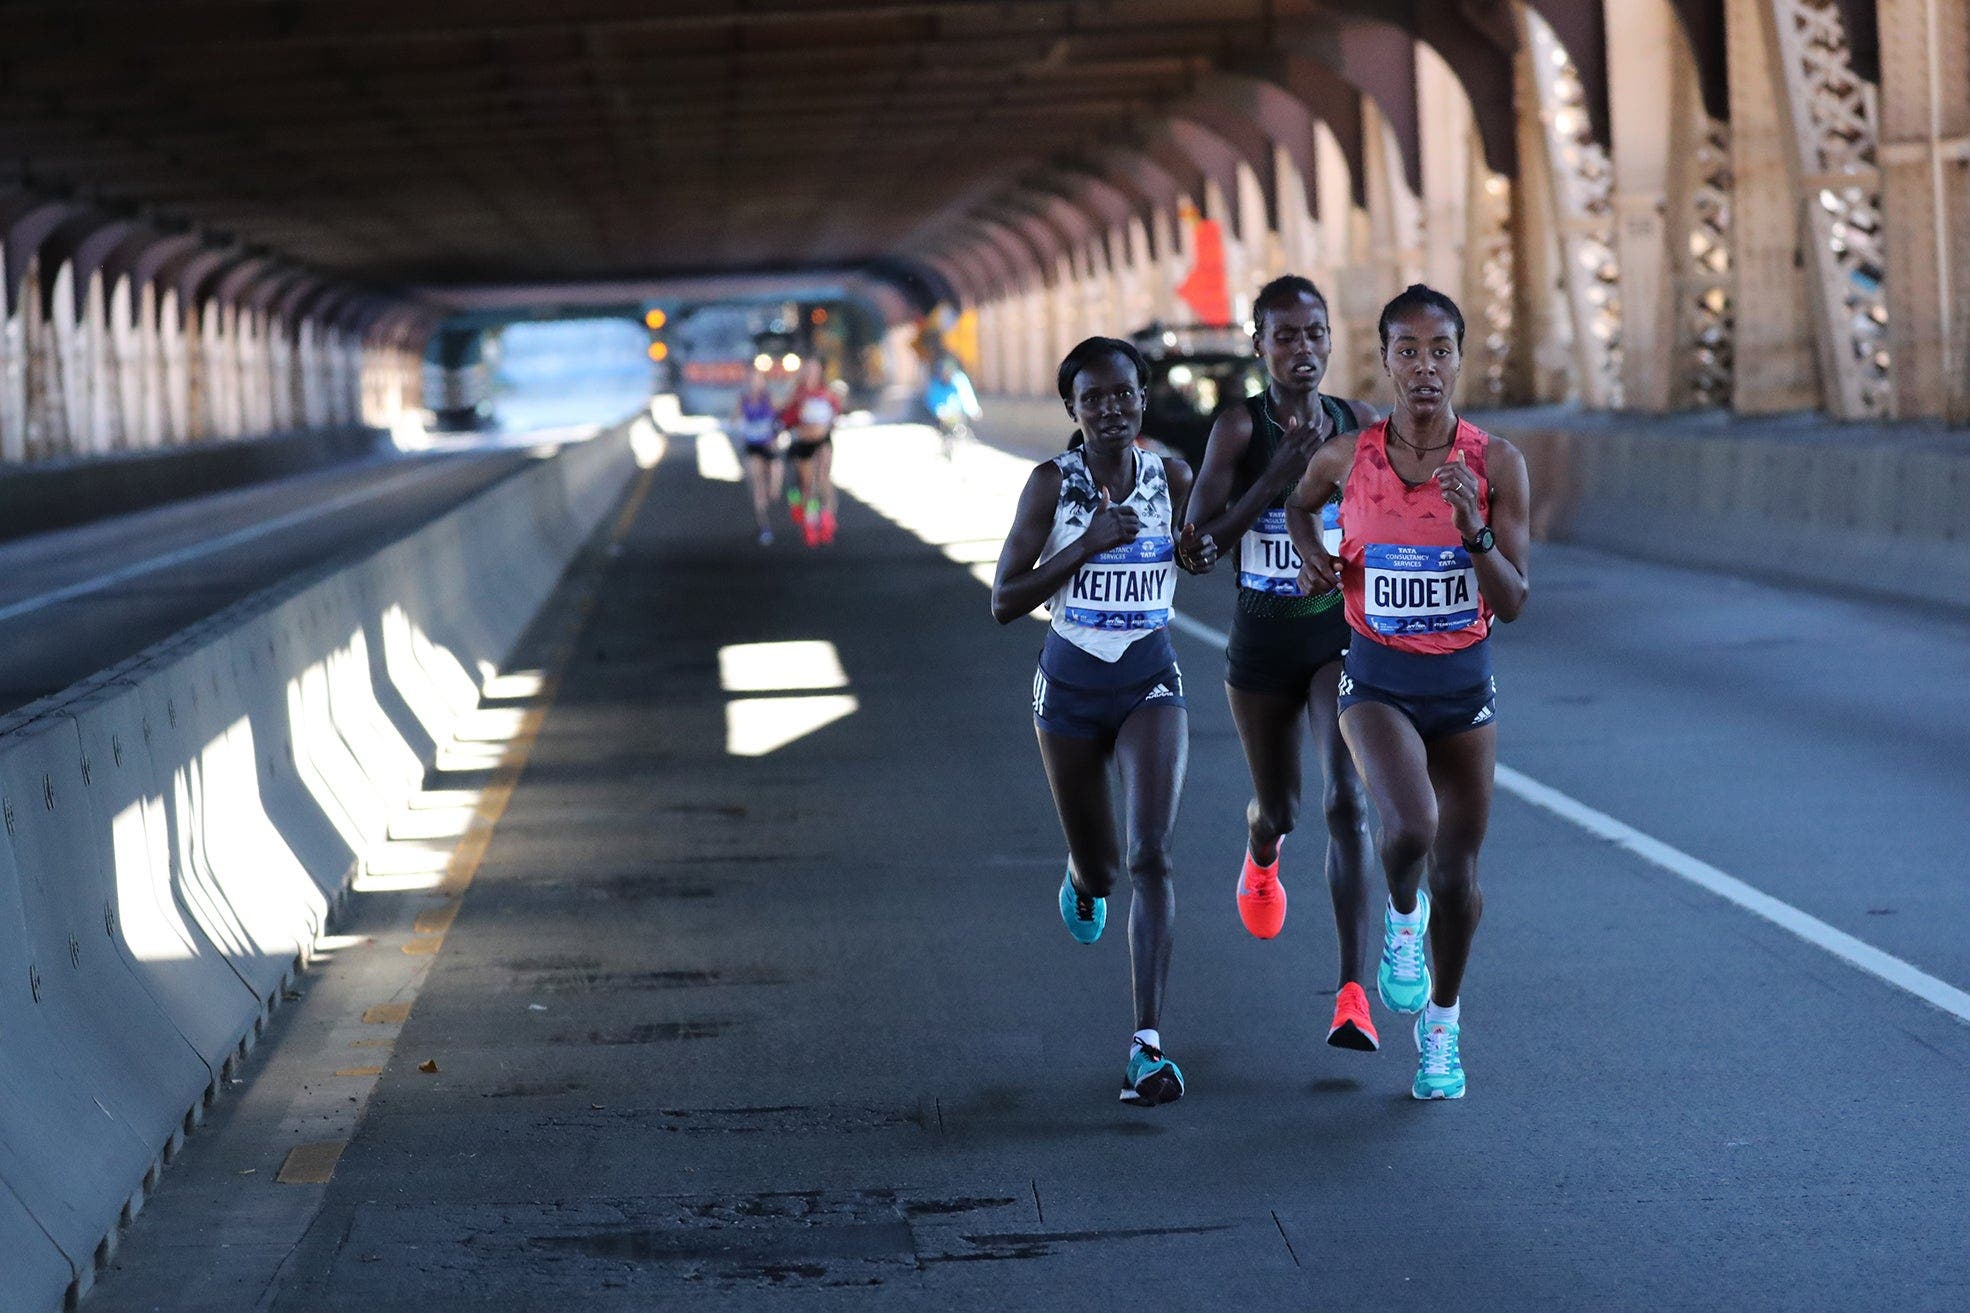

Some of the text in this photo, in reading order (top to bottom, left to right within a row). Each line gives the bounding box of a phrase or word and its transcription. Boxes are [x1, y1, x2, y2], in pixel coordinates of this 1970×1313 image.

[1393, 560, 1422, 568] SERVICES
[1073, 569, 1167, 602] KEITANY
[1375, 575, 1469, 608] GUDETA
